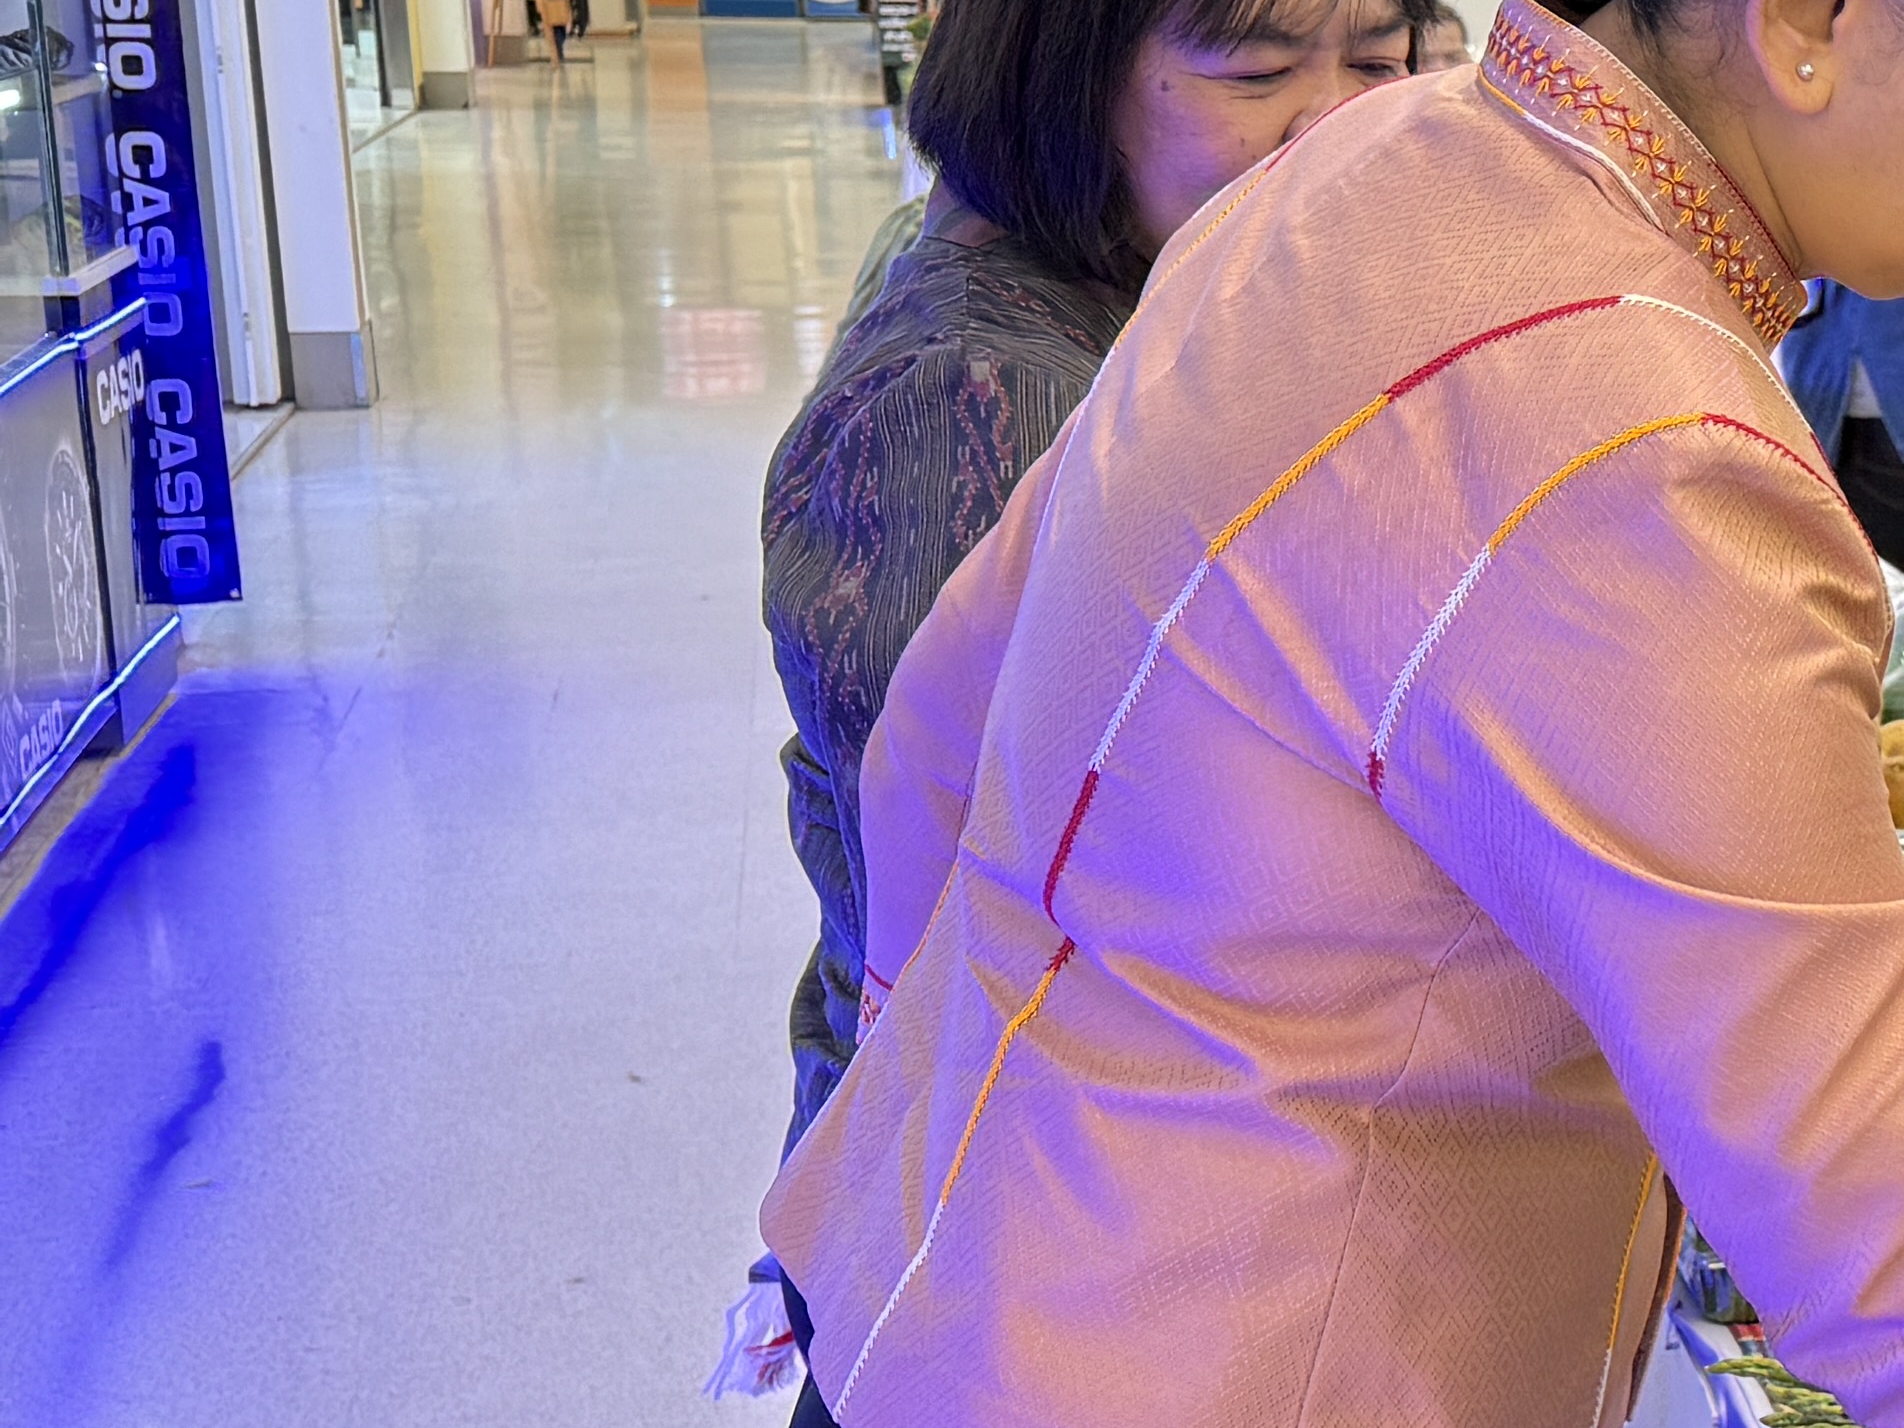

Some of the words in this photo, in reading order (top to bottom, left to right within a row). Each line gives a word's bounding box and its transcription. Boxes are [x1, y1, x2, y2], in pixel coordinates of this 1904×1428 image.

[119, 130, 184, 338] CASIO
[97, 348, 145, 425] CASIO
[146, 378, 211, 580] CASIO
